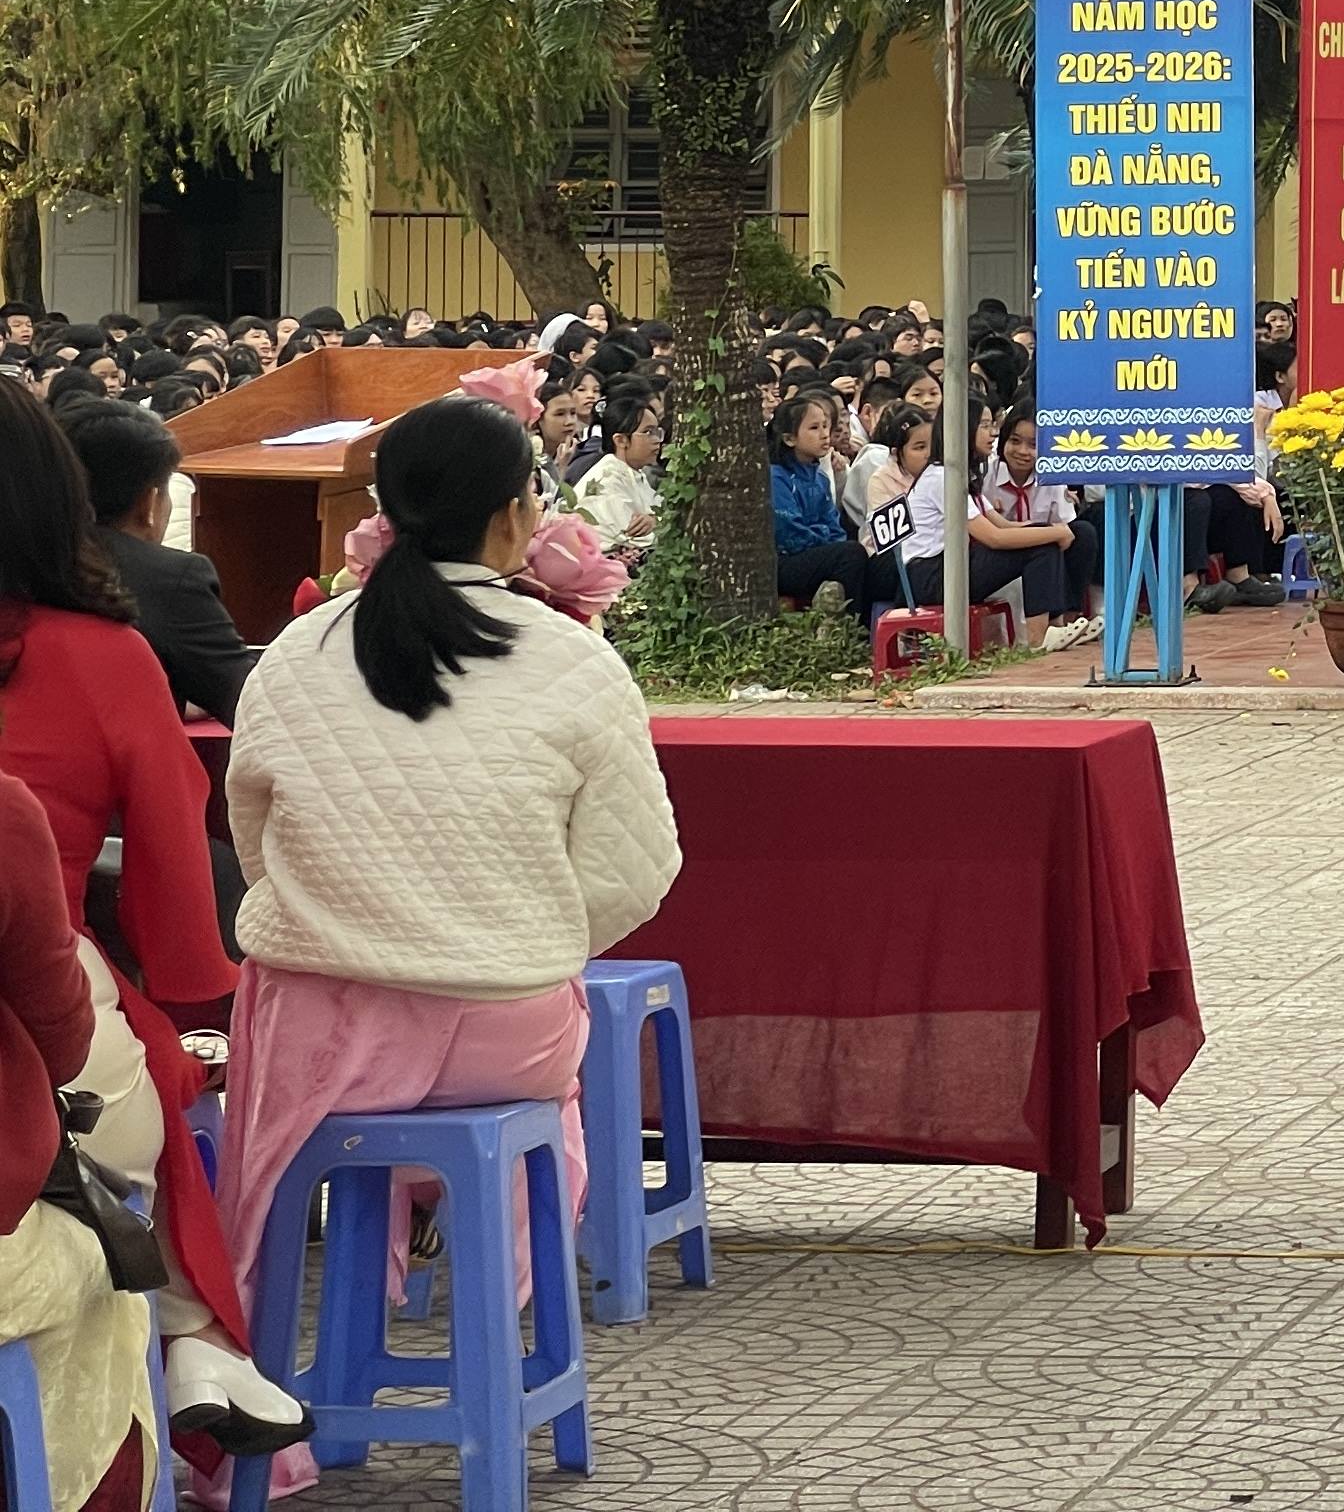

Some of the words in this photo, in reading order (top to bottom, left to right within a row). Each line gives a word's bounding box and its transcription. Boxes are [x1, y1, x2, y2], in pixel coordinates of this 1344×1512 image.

[1154, 0, 1217, 38] HỌC
[1058, 52, 1231, 83] 2025-2026:
[1070, 96, 1158, 135] THIẾU
[1167, 103, 1221, 133] NHI
[1070, 152, 1114, 186] ĐÀ
[1122, 147, 1221, 190] NẴNG,
[1058, 200, 1141, 238] VỮNG
[1150, 197, 1235, 236] BƯỚC
[1076, 250, 1146, 288] TIẾN
[1153, 250, 1216, 288] VÀO
[1058, 300, 1098, 339] KỶ
[1108, 300, 1235, 339] NGUYÊN
[1116, 354, 1178, 392] MỚI
[874, 503, 909, 545] 6/2
